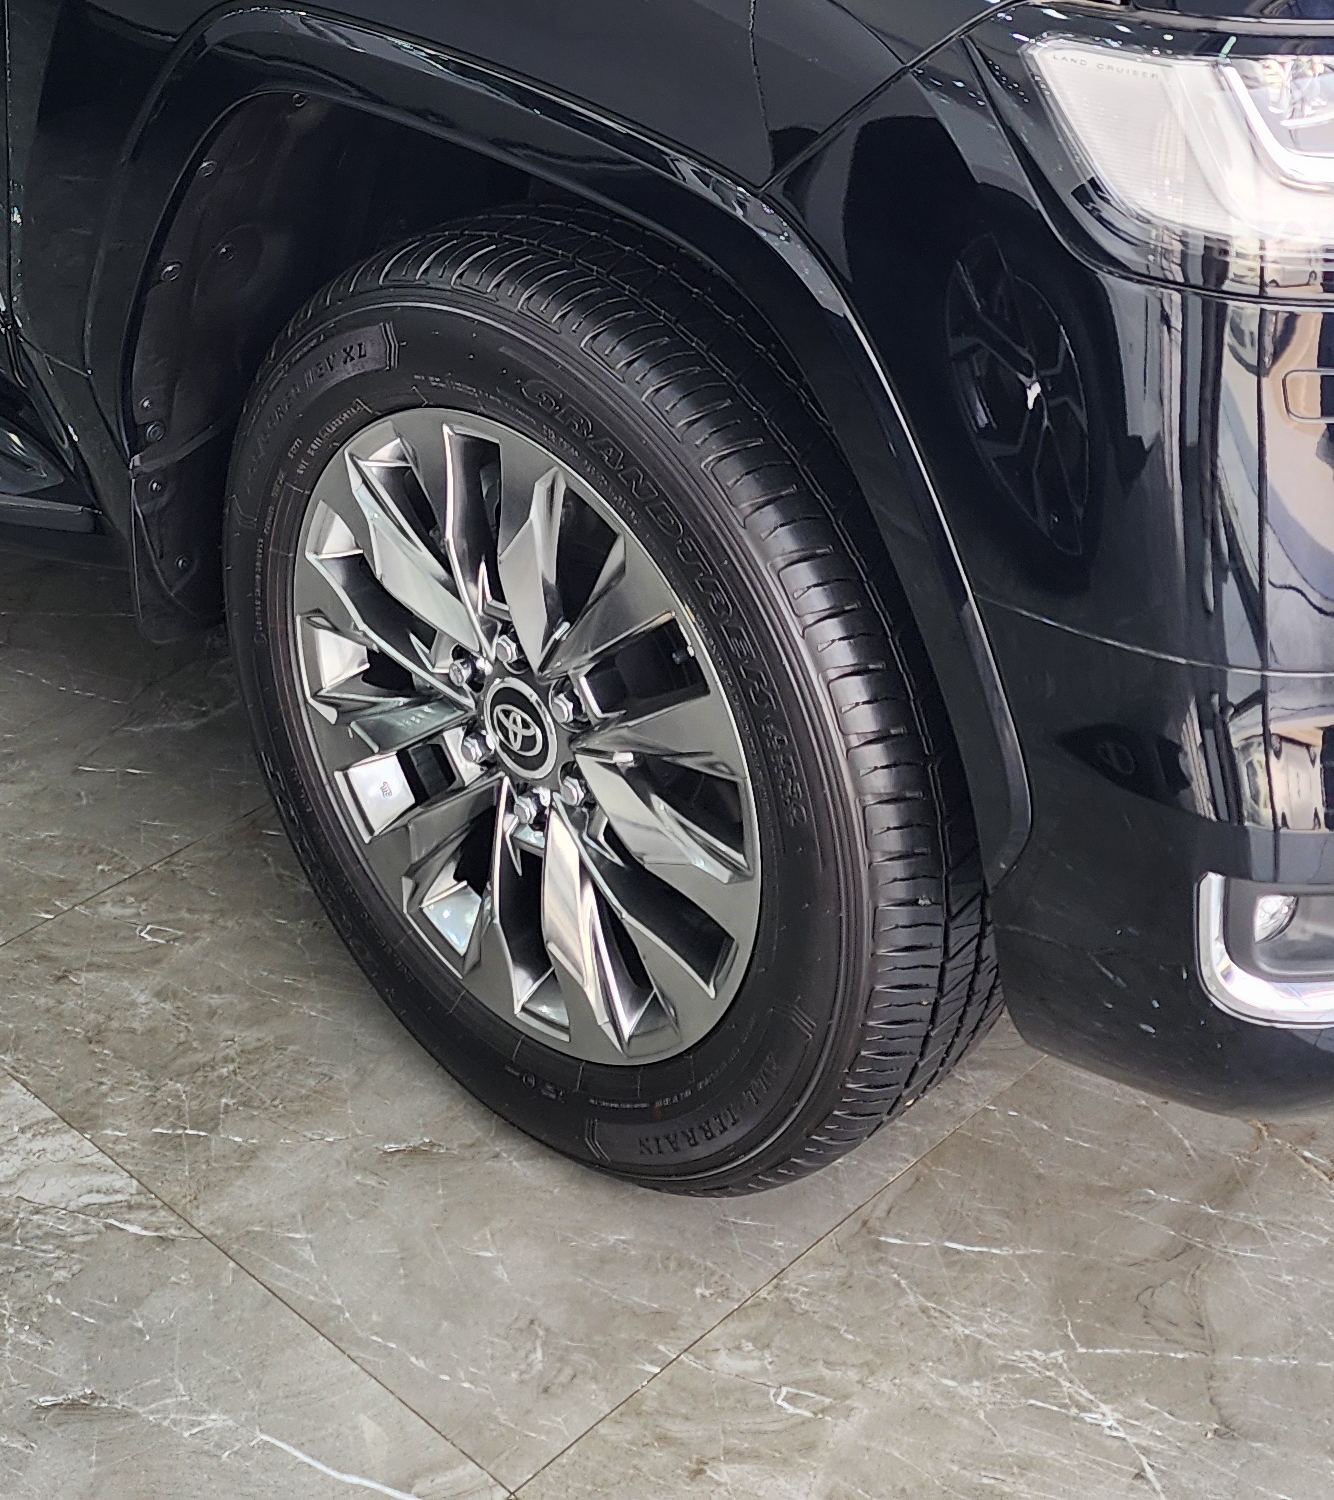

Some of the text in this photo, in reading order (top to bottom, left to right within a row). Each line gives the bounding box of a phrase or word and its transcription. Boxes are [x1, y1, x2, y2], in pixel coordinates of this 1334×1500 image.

[1053, 53, 1159, 80] LAND CRUISER
[336, 339, 371, 366] XL
[634, 1103, 741, 1155] TERRAIN
